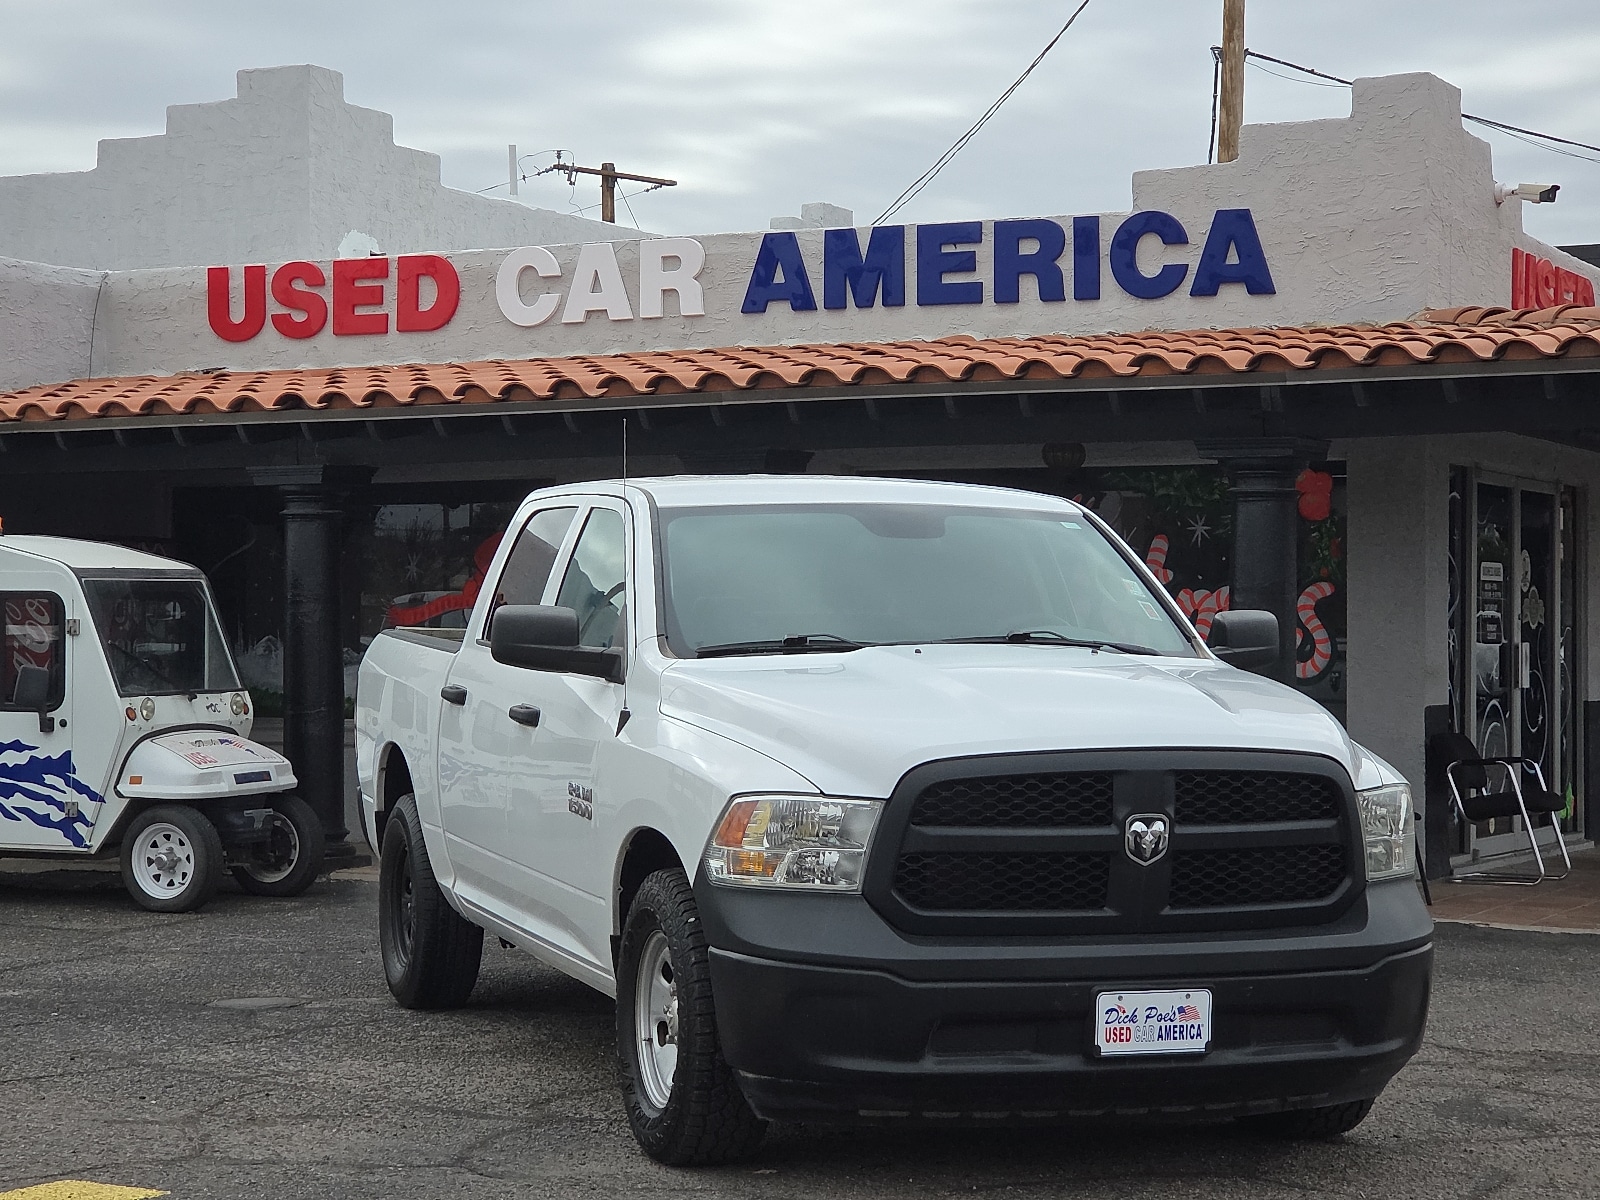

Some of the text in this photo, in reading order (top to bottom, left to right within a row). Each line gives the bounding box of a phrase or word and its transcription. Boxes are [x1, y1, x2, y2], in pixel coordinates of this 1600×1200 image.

[207, 209, 1275, 342] USED CAR AMERICA
[568, 782, 592, 803] RAM
[568, 798, 592, 820] 1500
[1105, 1005, 1177, 1024] Dick Poe's
[1105, 1024, 1202, 1043] USED CAR AMERICA
